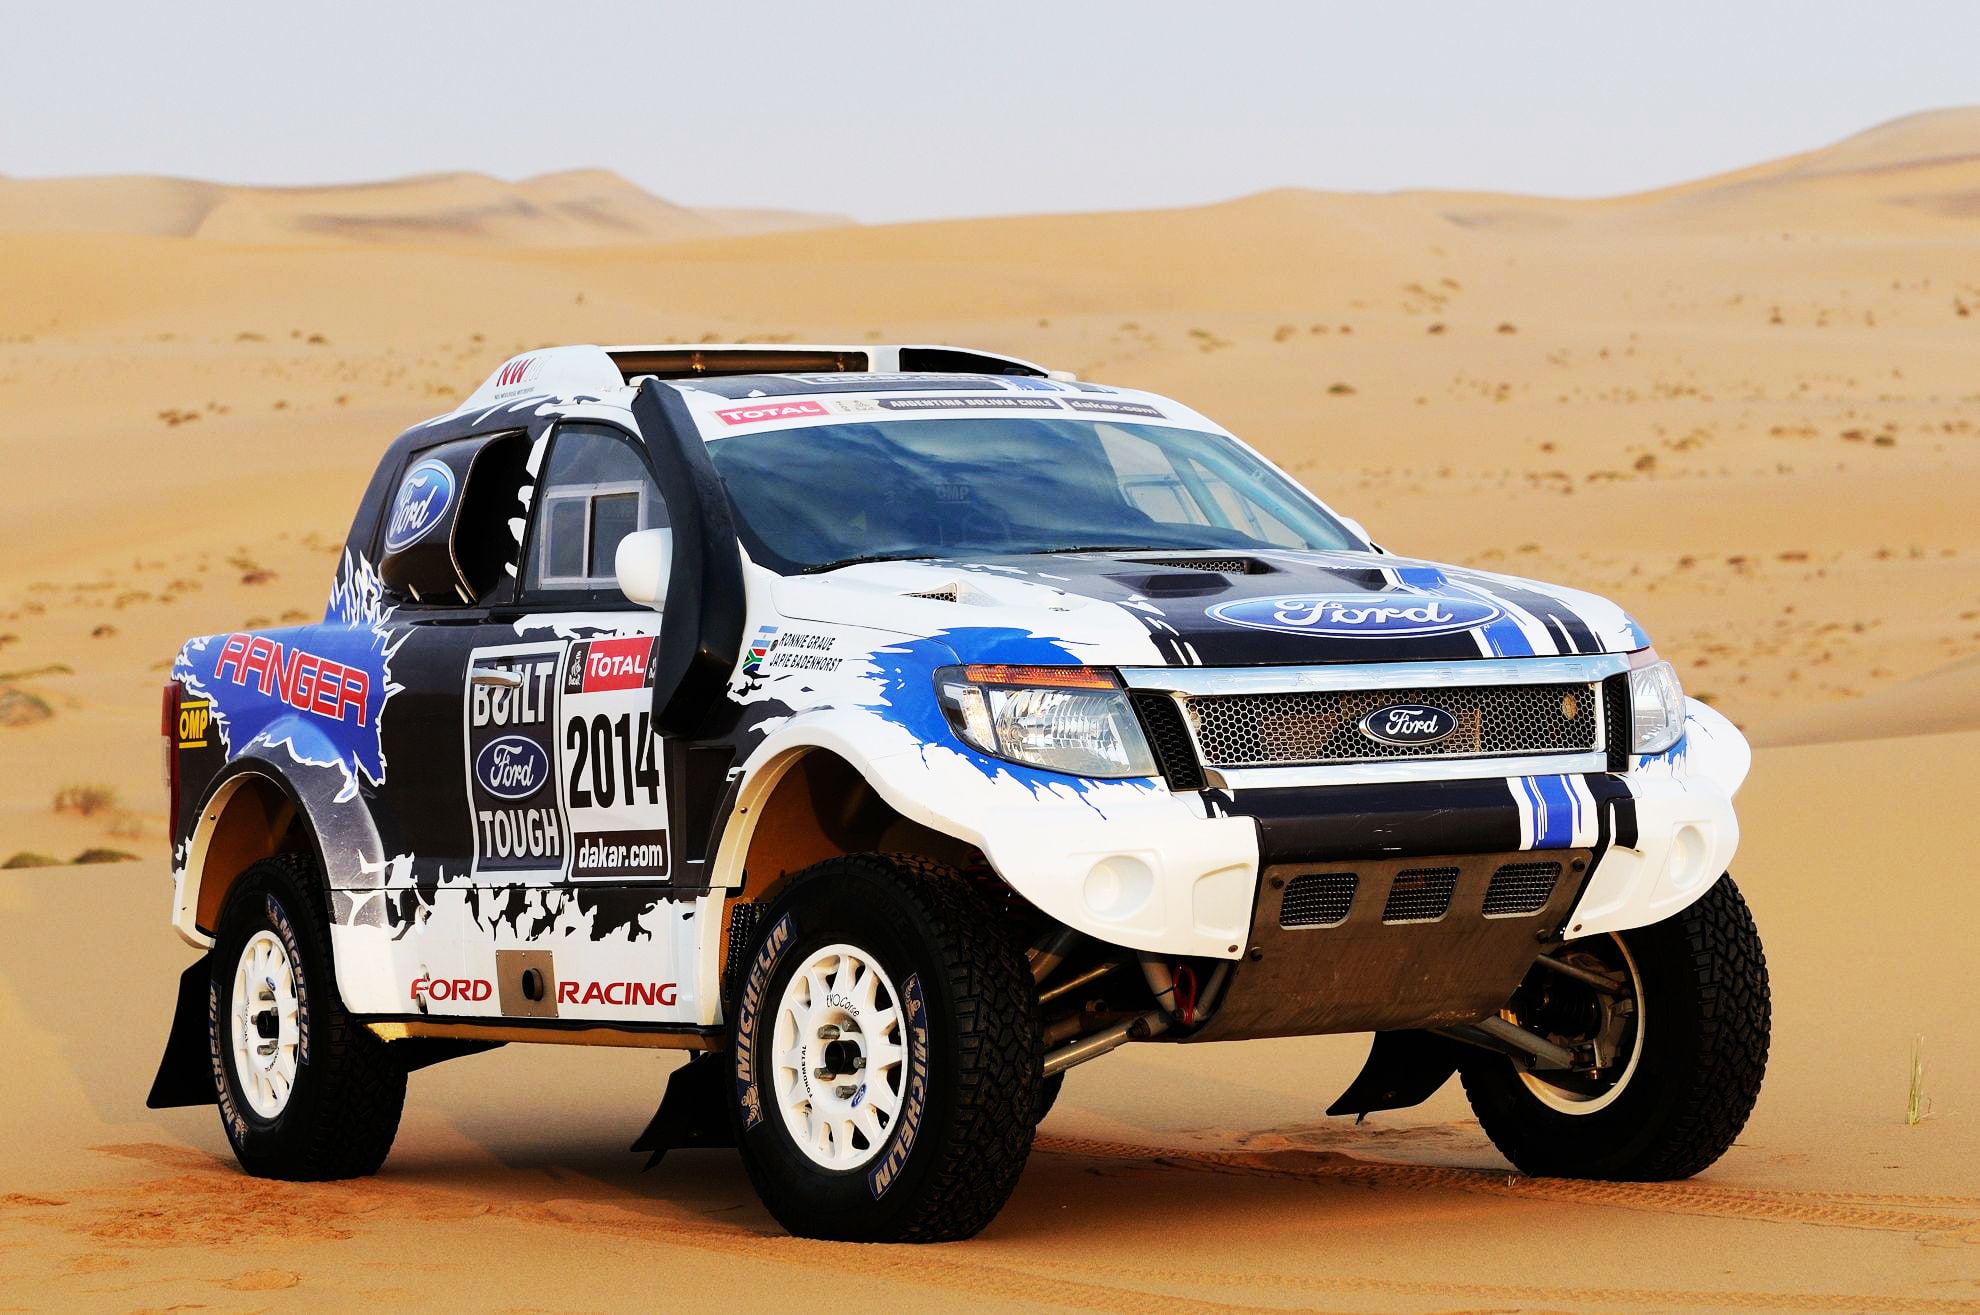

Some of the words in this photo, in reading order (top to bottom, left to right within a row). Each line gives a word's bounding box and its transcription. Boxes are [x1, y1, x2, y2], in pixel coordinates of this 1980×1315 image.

[722, 405, 821, 421] TOTAL
[890, 399, 965, 407] ARGENTINA
[965, 399, 1018, 407] BOLIVIA
[1018, 399, 1055, 408] CHILE
[1071, 401, 1158, 415] dakar.com
[389, 474, 439, 539] Ford
[1273, 598, 1454, 626] Ford
[778, 632, 810, 648] RONNIE
[807, 635, 836, 651] GRAUE
[590, 652, 645, 678] TOTAL
[769, 652, 793, 668] JAPIE
[790, 653, 844, 672] BADENHORST
[214, 632, 370, 728] RANGER
[178, 708, 209, 740] OMP
[1385, 709, 1438, 735] Ford
[490, 744, 534, 788] Ford
[566, 711, 660, 809] 2014
[479, 808, 560, 859] TOUGH
[578, 838, 663, 869] dakar.com
[410, 979, 493, 1002] FORD
[557, 981, 677, 1006] RACING
[737, 915, 790, 1081] MICHELIN
[874, 1026, 926, 1194] MICHELIN
